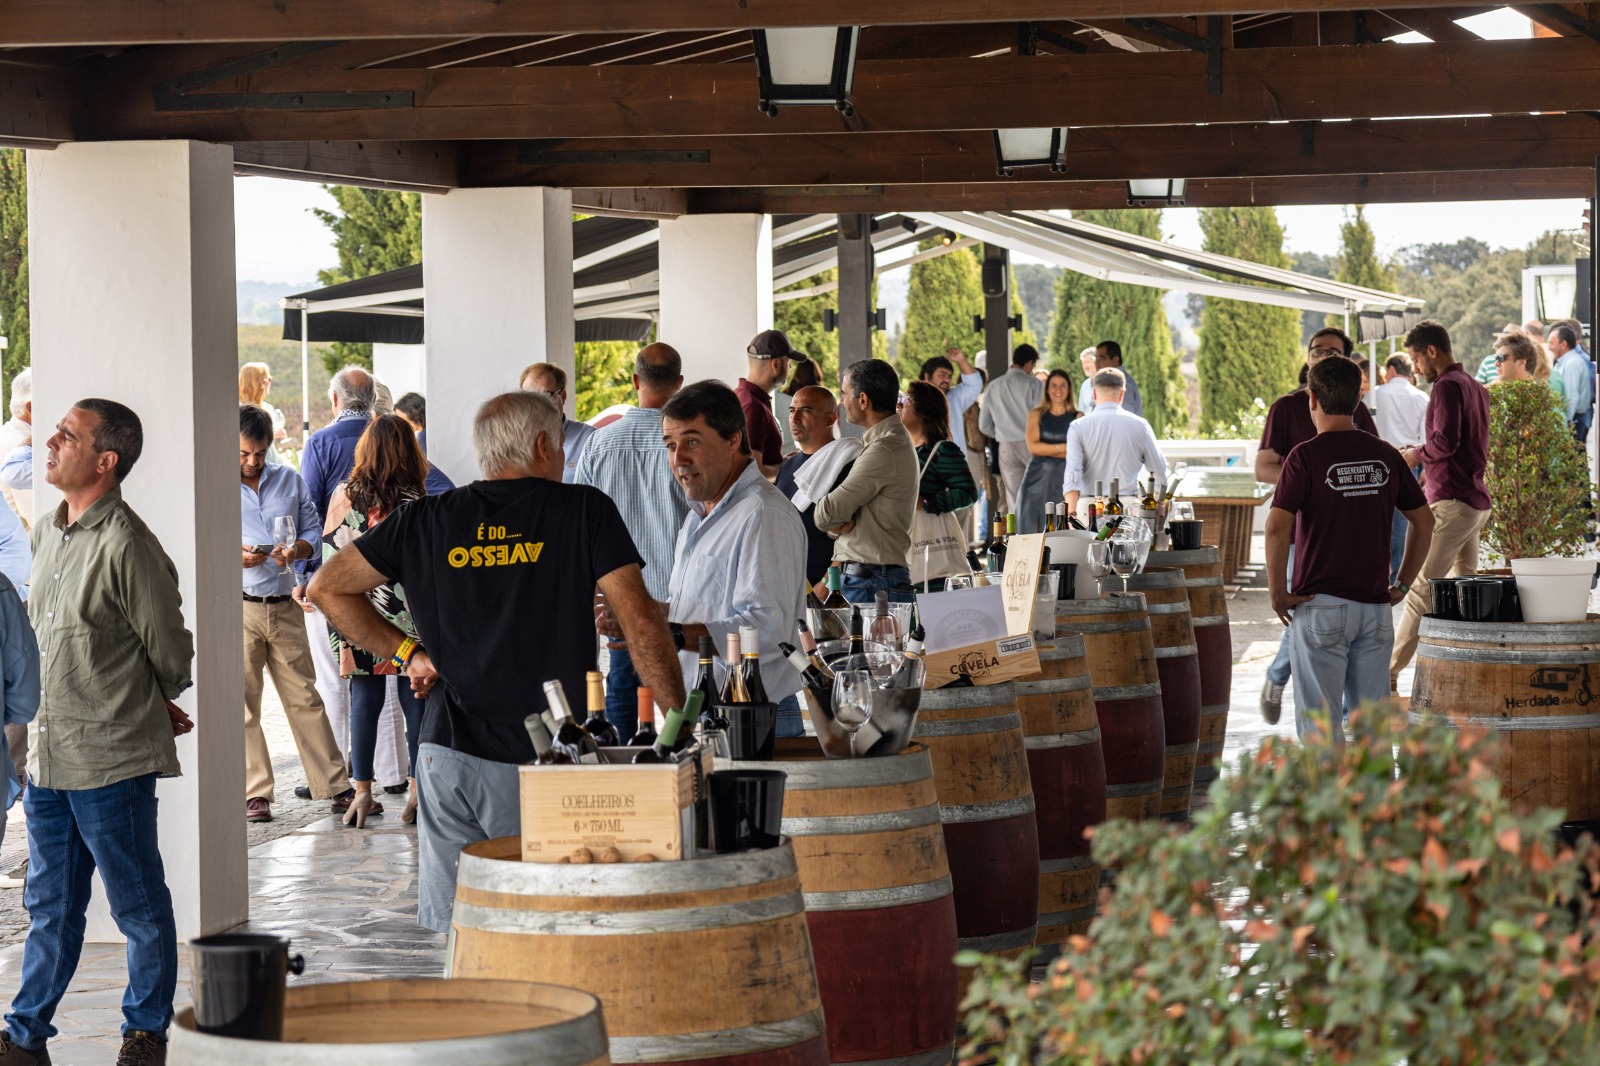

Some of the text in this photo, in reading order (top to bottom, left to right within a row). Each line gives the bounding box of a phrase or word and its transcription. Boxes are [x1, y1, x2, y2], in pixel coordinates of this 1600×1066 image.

[1336, 465, 1375, 476] REGENERATIVE
[1338, 474, 1366, 484] WINE FEST
[477, 523, 485, 540] É
[914, 539, 935, 548] VIDAL
[448, 542, 544, 568] AVESSO
[950, 657, 1000, 675] COVELA
[1505, 694, 1560, 709] Herdade
[1561, 696, 1575, 705] das
[562, 795, 635, 809] COELHEIROS
[574, 820, 580, 833] 6
[590, 820, 607, 833] 750
[608, 819, 624, 833] ML
